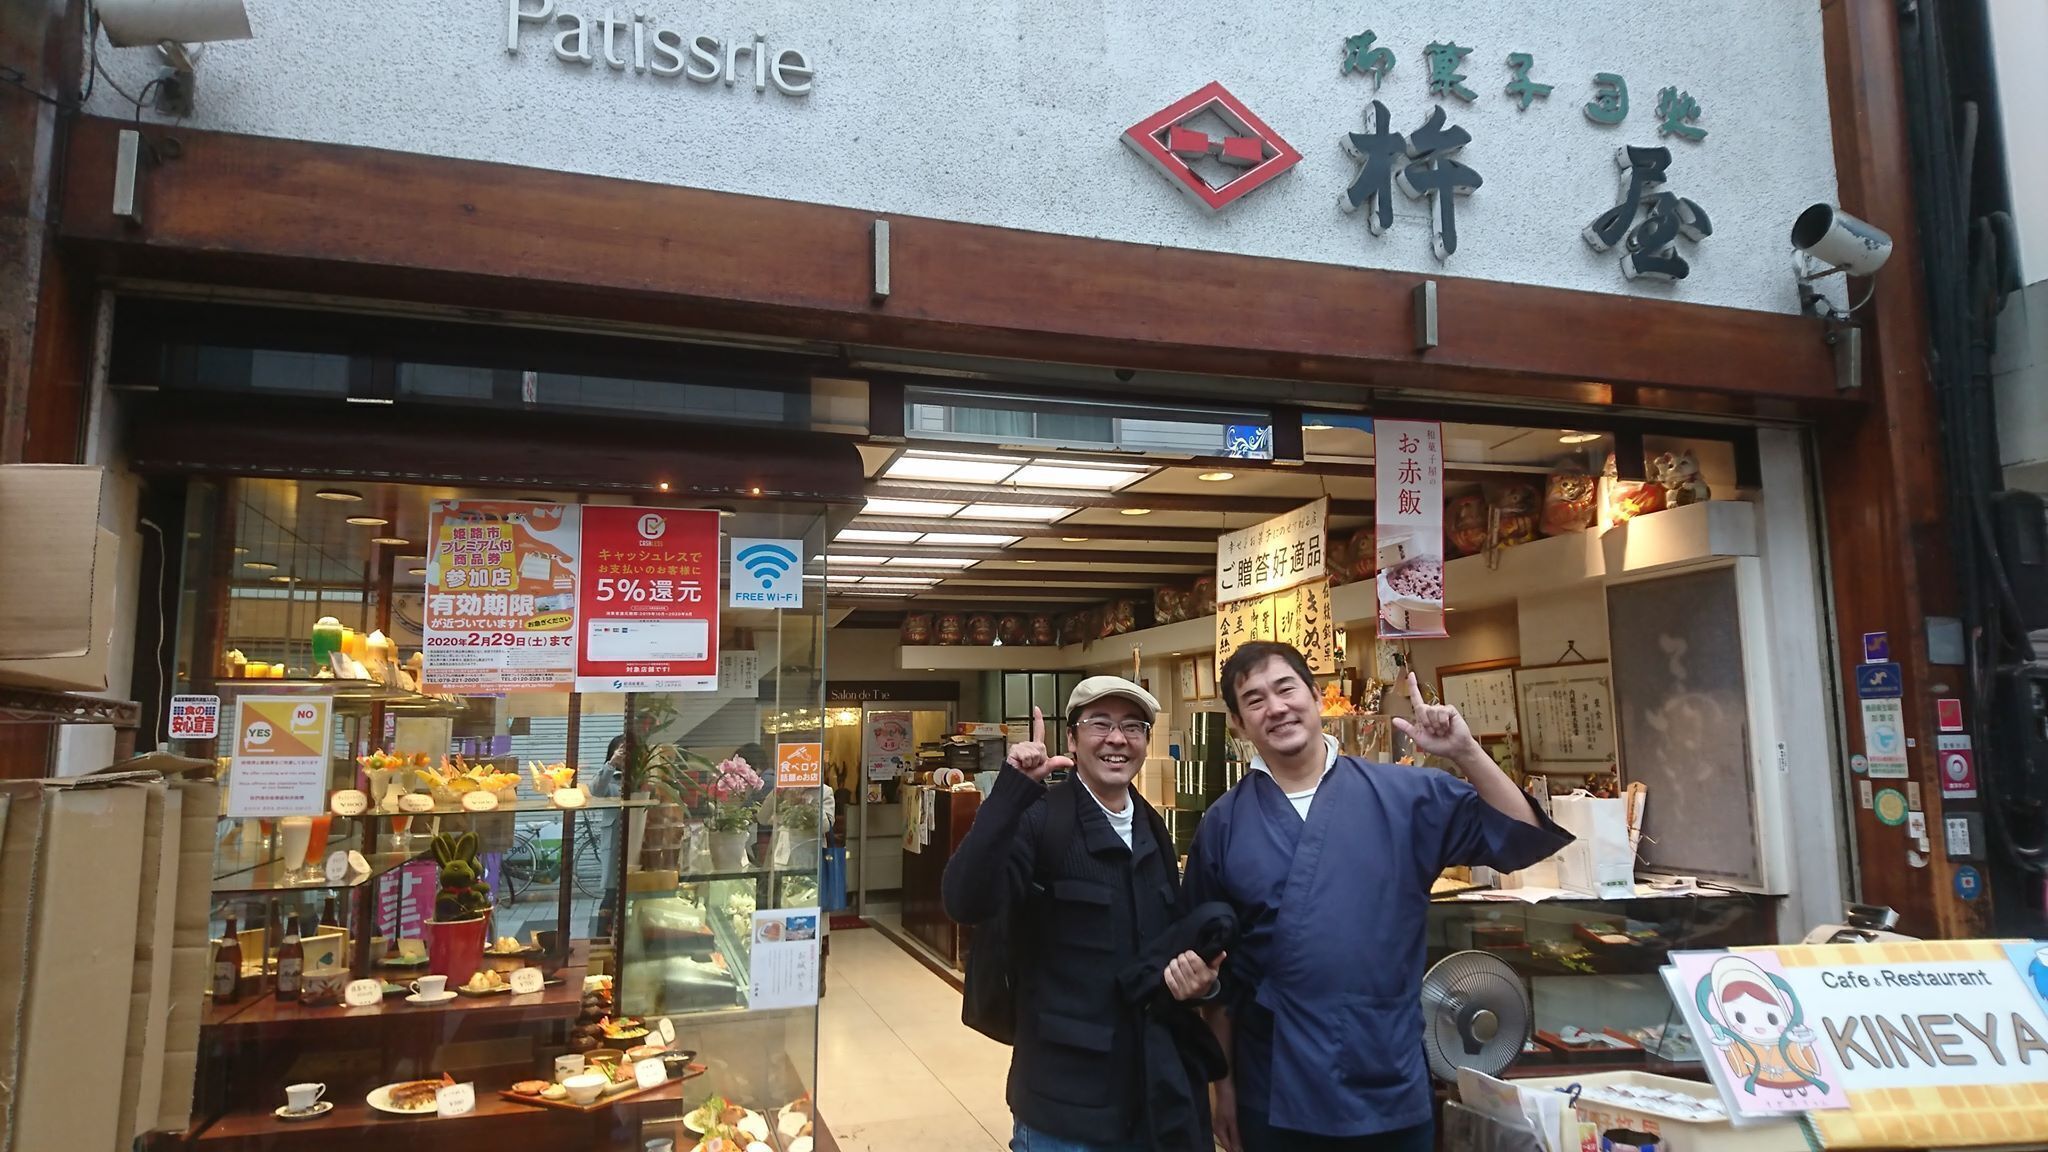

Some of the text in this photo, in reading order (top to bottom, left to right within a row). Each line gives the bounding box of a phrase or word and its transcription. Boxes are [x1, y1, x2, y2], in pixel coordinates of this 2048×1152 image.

[1337, 99, 1713, 281] 杵屋
[1426, 429, 1438, 486] 和菓子屋の
[1397, 432, 1422, 516] お赤飯
[453, 526, 501, 540] 姫路市
[441, 539, 513, 553] プレミアム付
[453, 552, 502, 566] 商品券
[598, 548, 703, 563] キャッシュレスで
[1221, 534, 1321, 590] ご贈答好適品
[598, 564, 702, 576] お支払いのお客様に
[446, 568, 511, 588] 参加店
[596, 578, 702, 602] 5%還元
[735, 592, 798, 602] FREE Wi-Fi
[429, 592, 535, 617] 有効期限
[831, 689, 857, 700] Salon
[858, 689, 871, 700] de
[185, 705, 205, 715] 食の
[297, 710, 313, 719] NO
[172, 715, 216, 733] 安心宣言
[248, 728, 271, 738] YES
[780, 760, 819, 772] 食べログ
[780, 773, 819, 782] 話題のお店
[1821, 968, 1992, 990] Cafe & Restaurant
[1821, 1012, 2048, 1071] KINEYA
